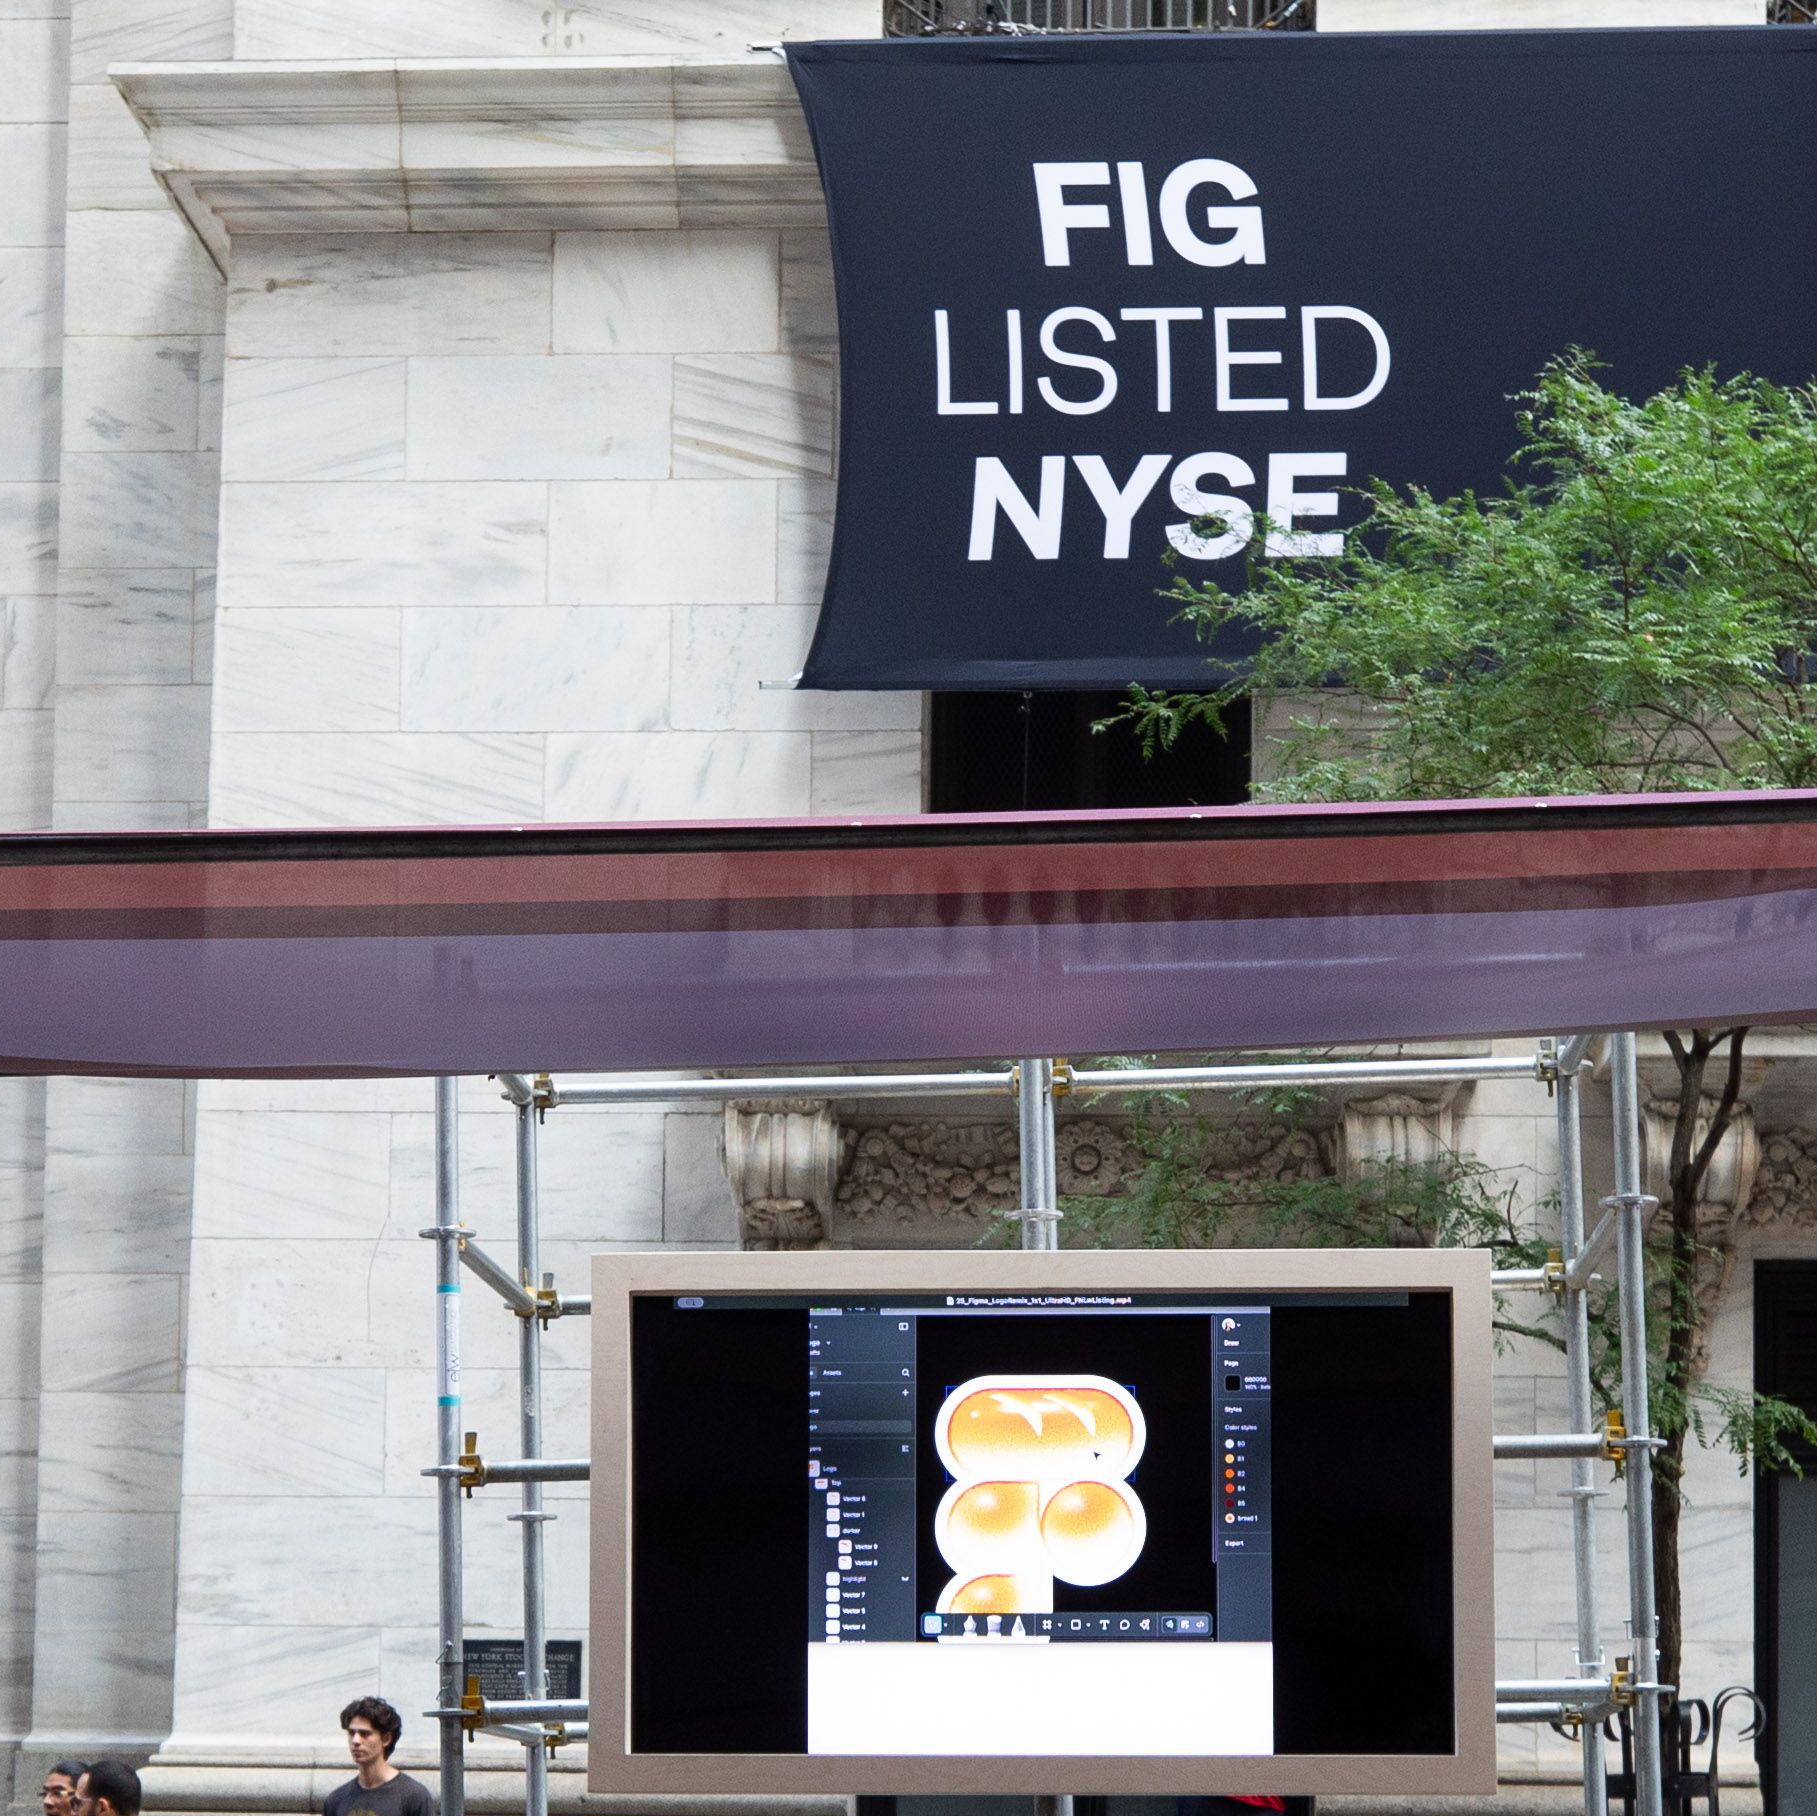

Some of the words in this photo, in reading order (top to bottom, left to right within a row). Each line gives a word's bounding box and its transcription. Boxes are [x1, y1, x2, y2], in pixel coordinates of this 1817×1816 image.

[1033, 158, 1266, 267] FIG
[934, 306, 1391, 415] LISTED
[968, 452, 1348, 560] NYSE
[505, 1653, 525, 1661] STOC
